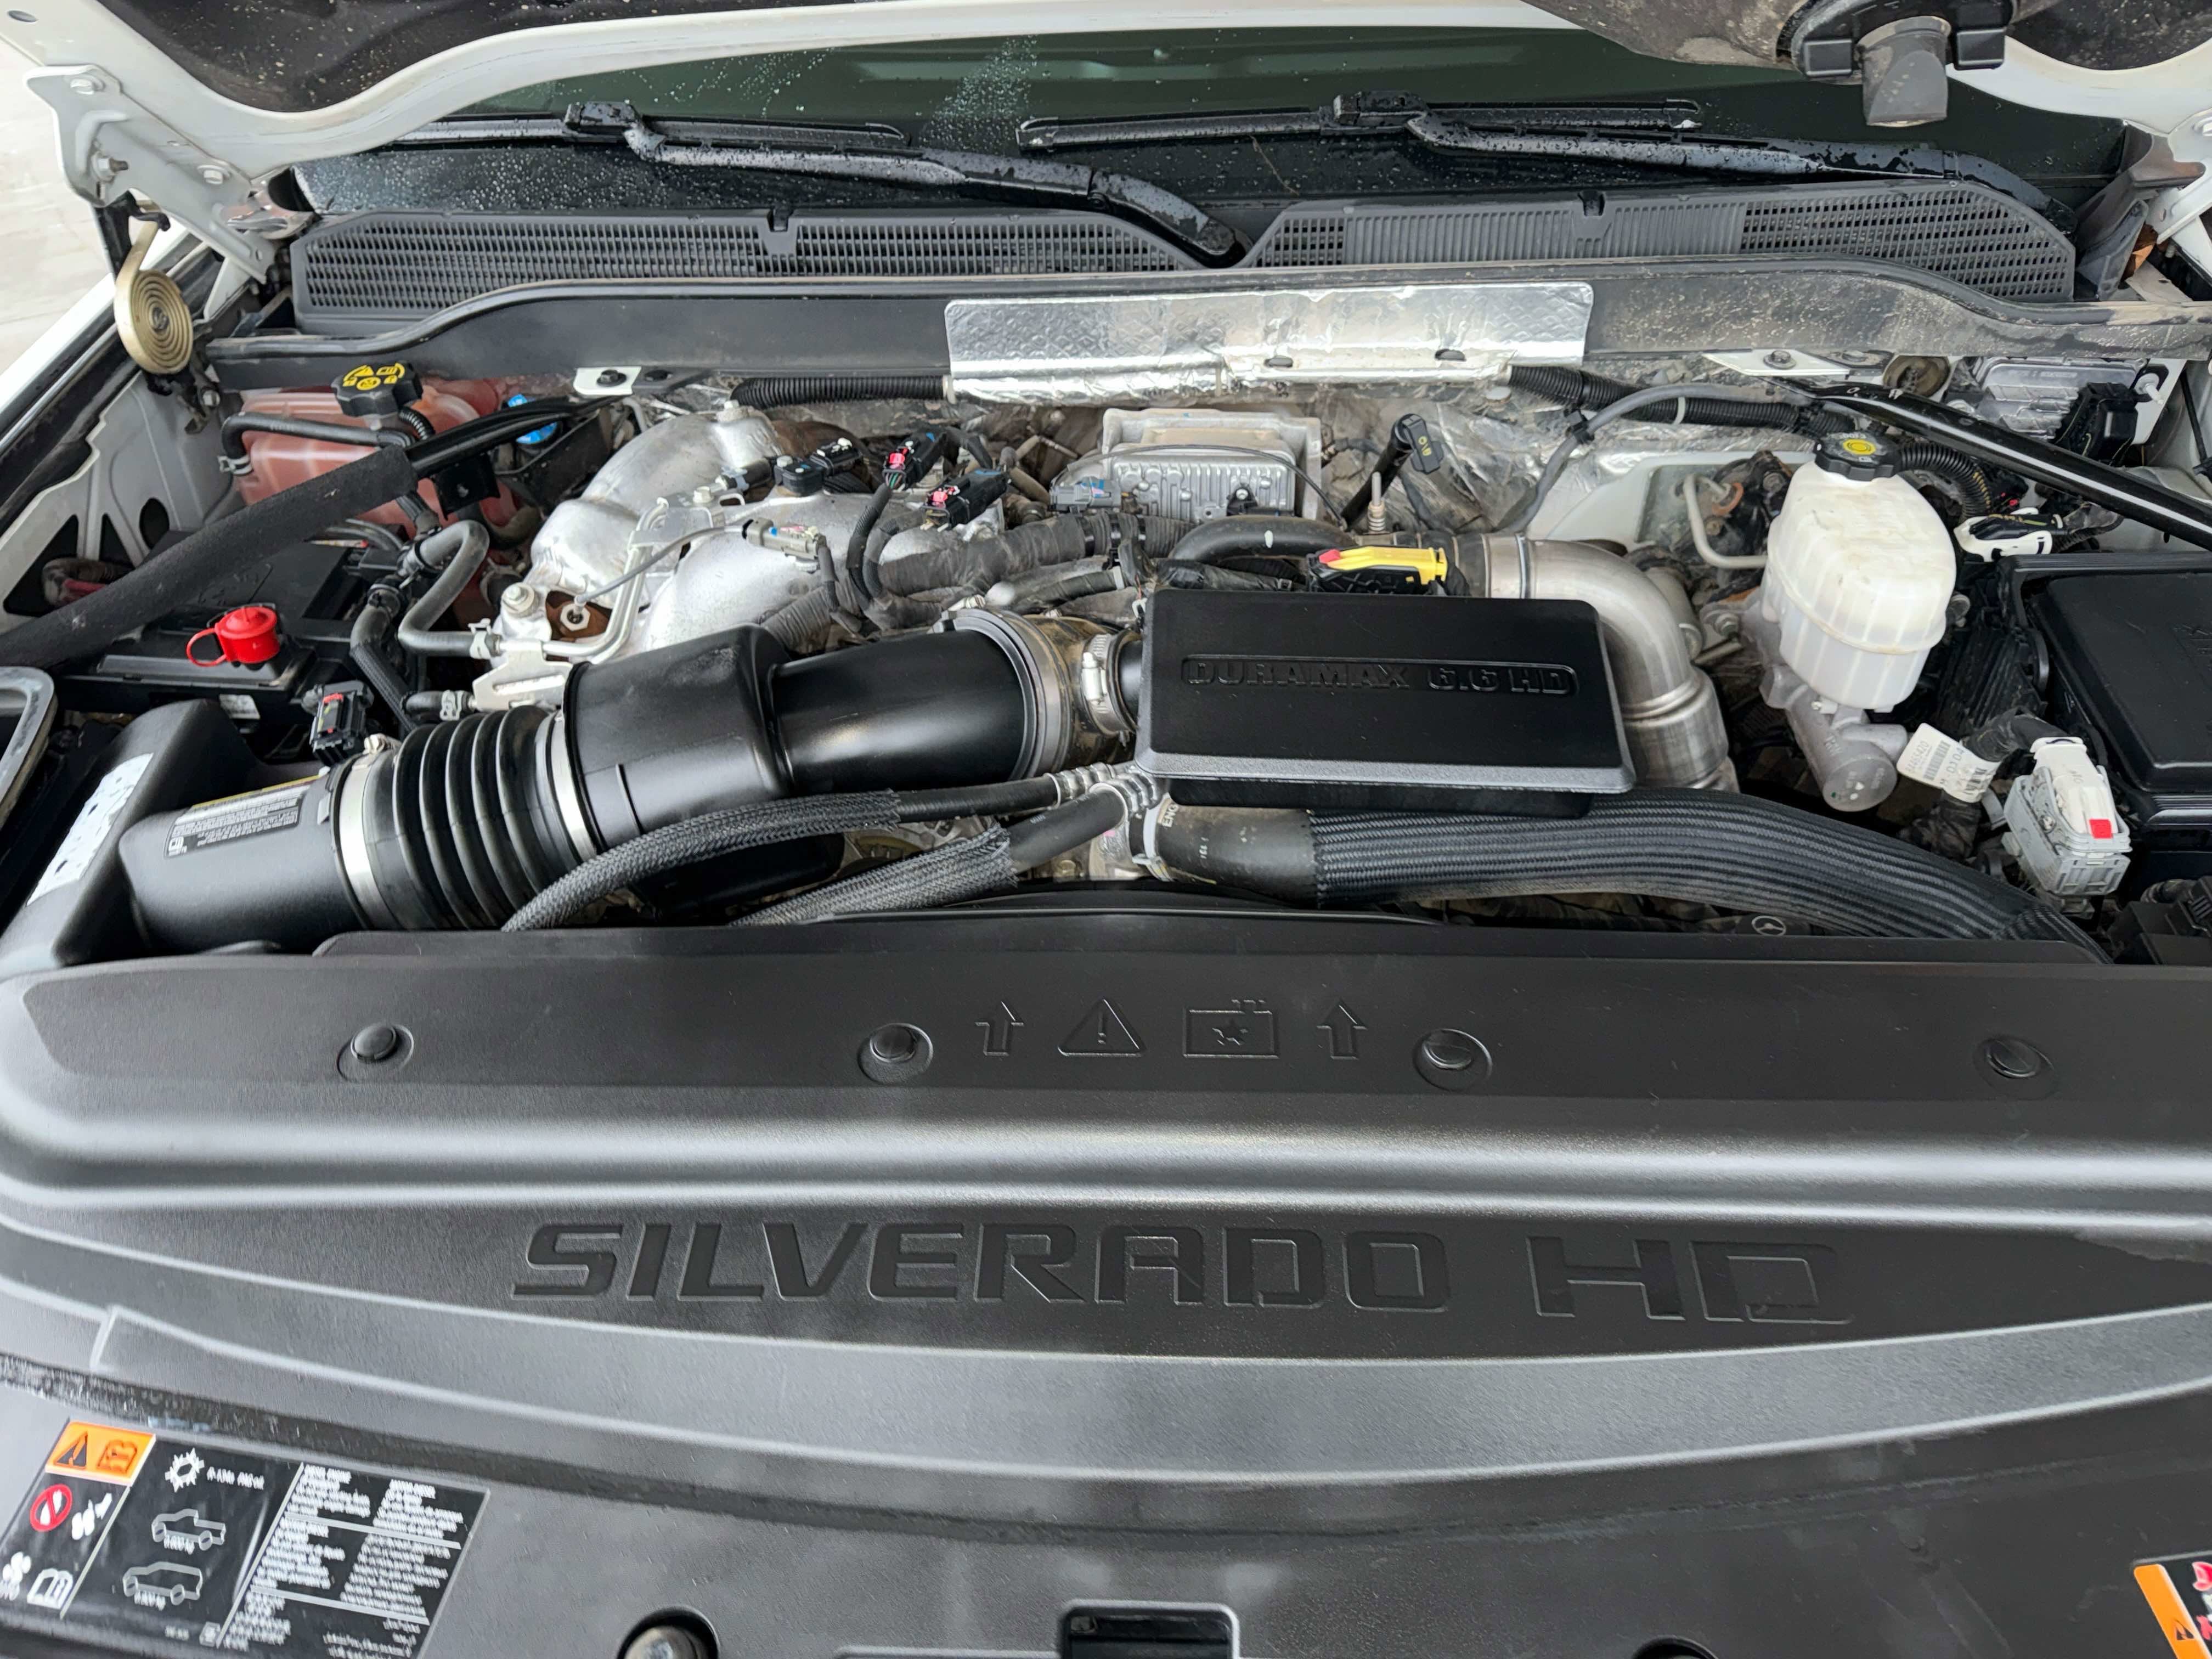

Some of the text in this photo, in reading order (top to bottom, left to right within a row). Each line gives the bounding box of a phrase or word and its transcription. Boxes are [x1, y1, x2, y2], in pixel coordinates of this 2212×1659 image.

[1187, 661, 1410, 690] DURAMAX
[1510, 668, 1571, 695] HD
[1161, 803, 1179, 828] ENG
[511, 1222, 1856, 1324] SILVERADO HD
